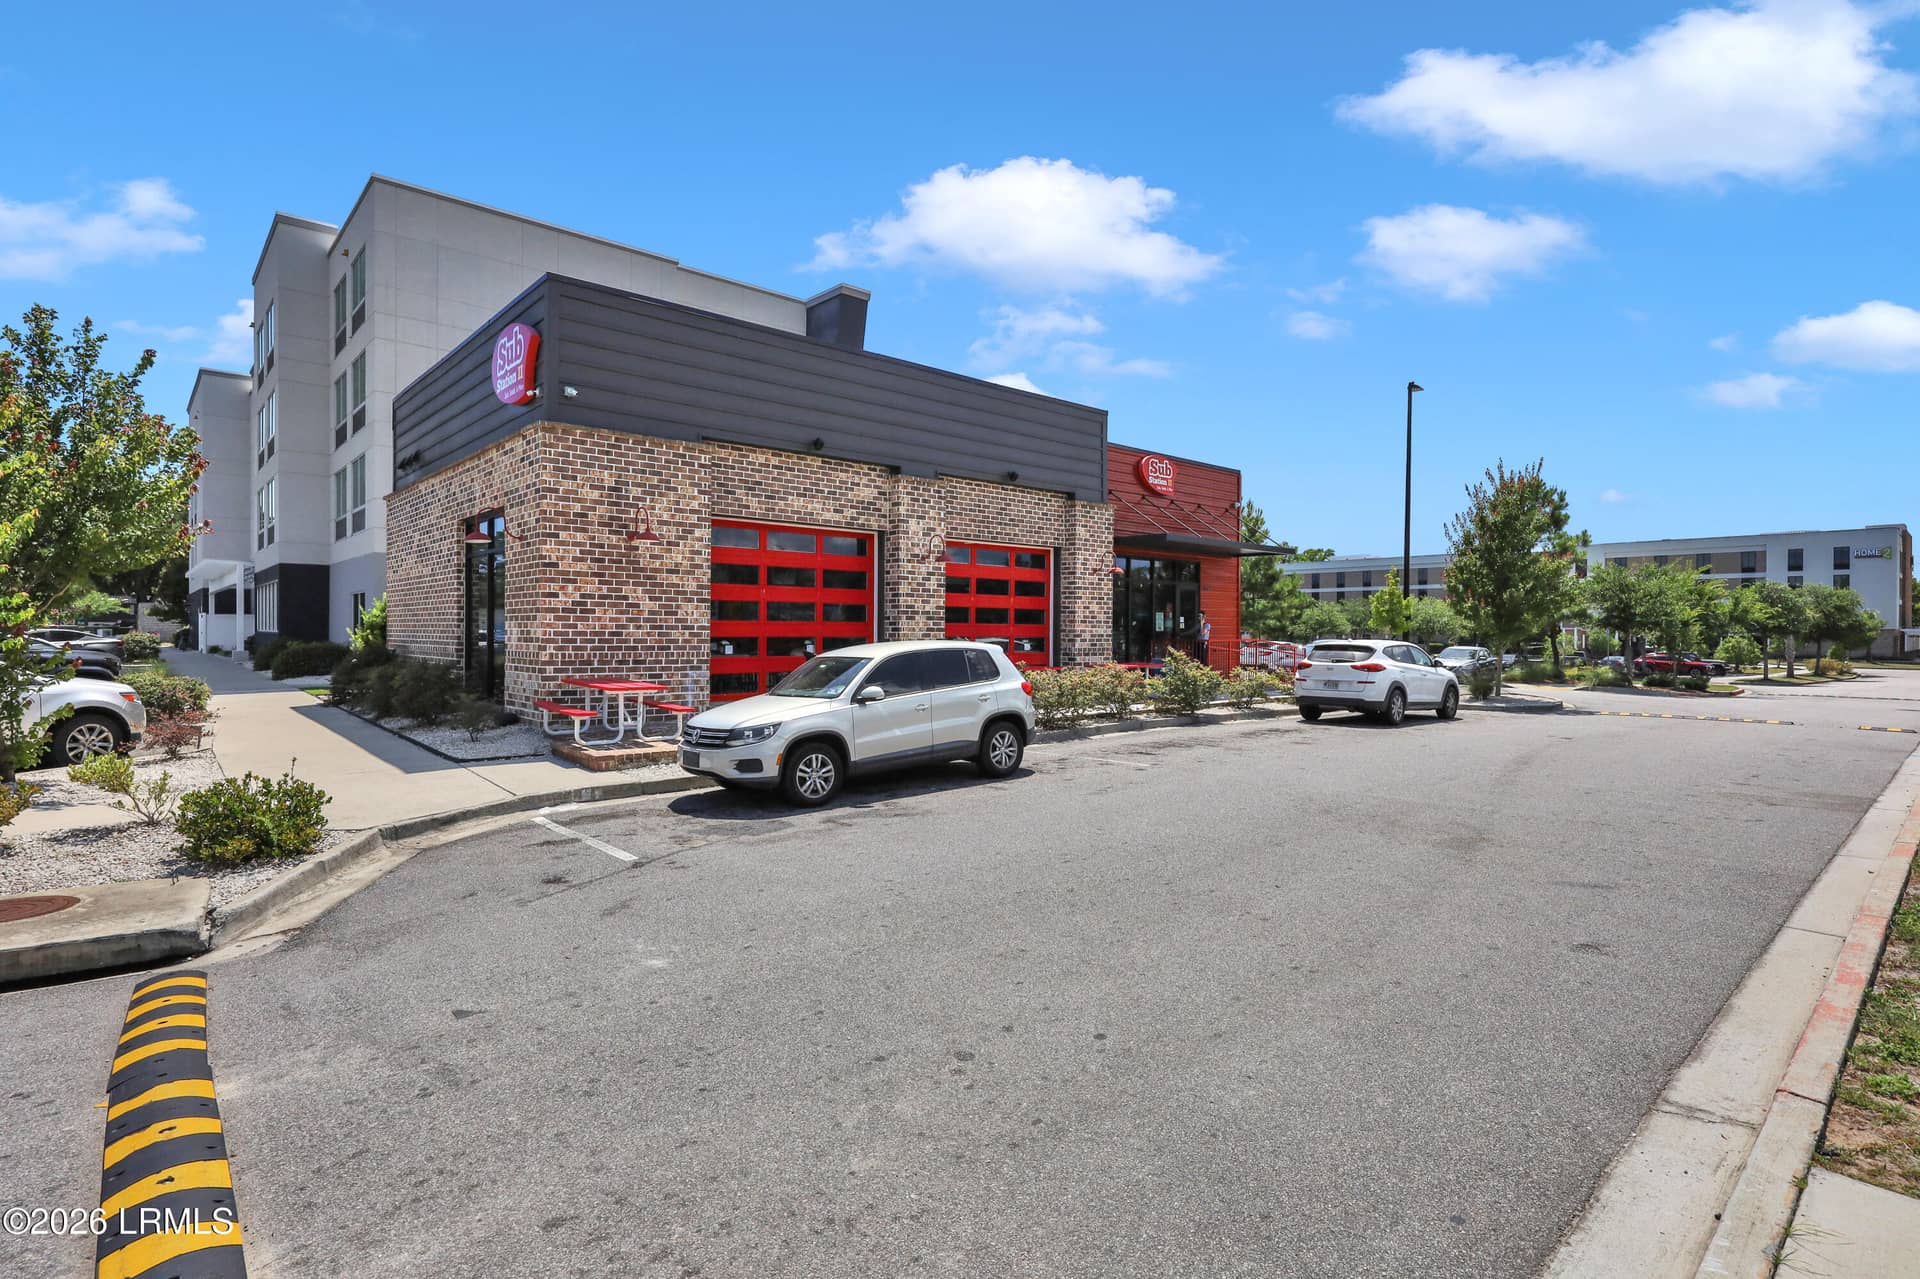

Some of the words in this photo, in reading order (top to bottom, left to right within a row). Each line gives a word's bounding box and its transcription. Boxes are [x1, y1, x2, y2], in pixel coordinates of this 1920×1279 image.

[497, 326, 524, 377] Sub
[496, 371, 517, 394] Station
[1149, 459, 1173, 478] Sub
